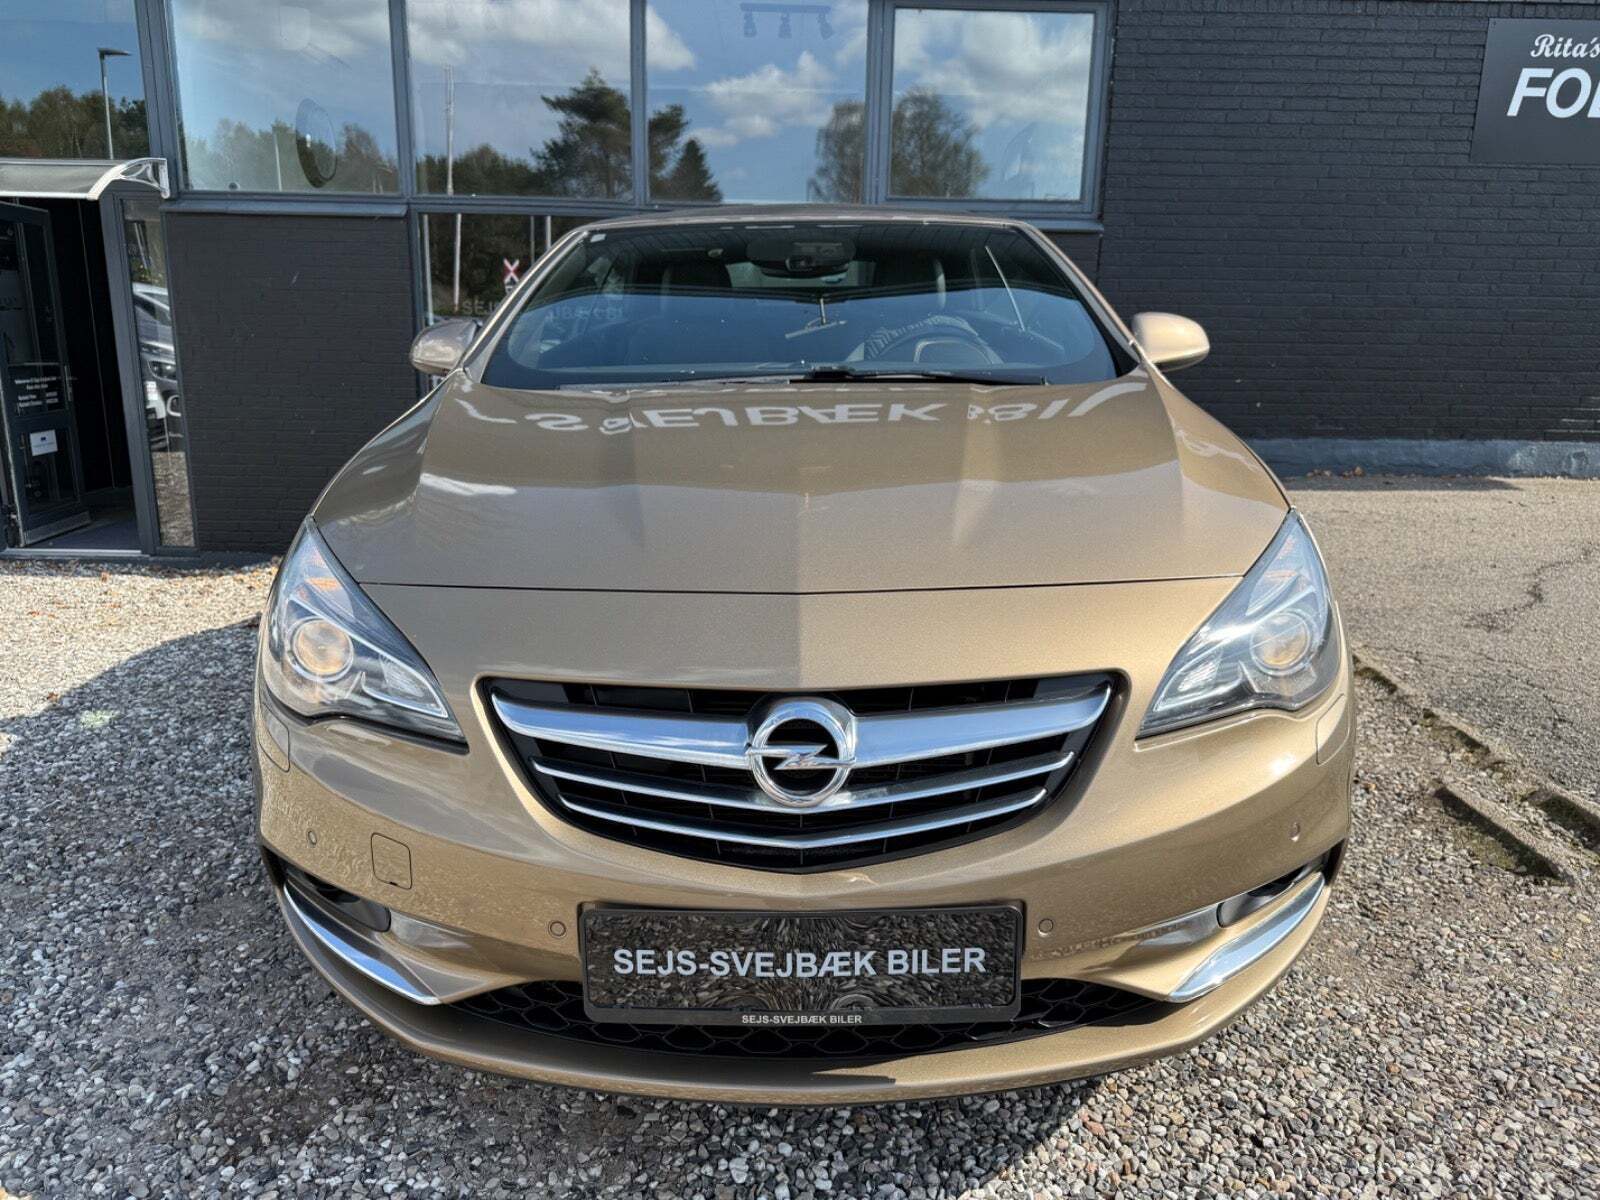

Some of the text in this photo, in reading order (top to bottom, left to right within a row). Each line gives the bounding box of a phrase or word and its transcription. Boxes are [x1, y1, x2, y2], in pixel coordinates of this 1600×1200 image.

[614, 947, 986, 978] SEJS-SVEJBÆK BILER
[742, 1014, 862, 1024] SEJS-SVEJBÆK BILER
